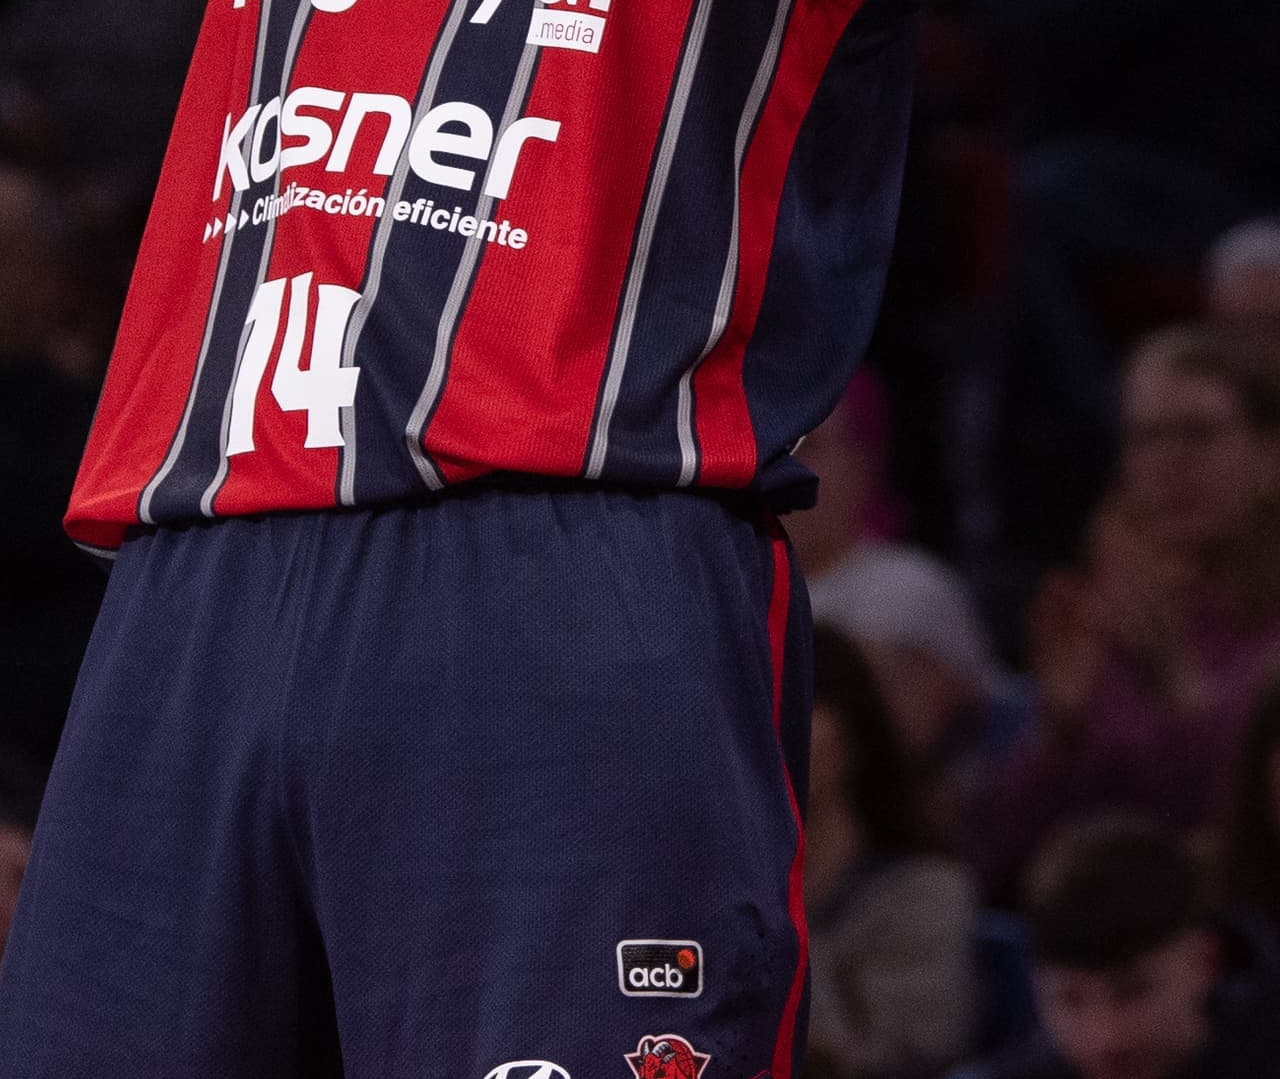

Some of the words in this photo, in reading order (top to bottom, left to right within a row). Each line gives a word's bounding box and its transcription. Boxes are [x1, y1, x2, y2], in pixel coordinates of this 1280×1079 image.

[251, 181, 387, 226] Climatización
[392, 198, 529, 250] eficiente
[226, 271, 363, 457] 14
[629, 963, 683, 988] acb
